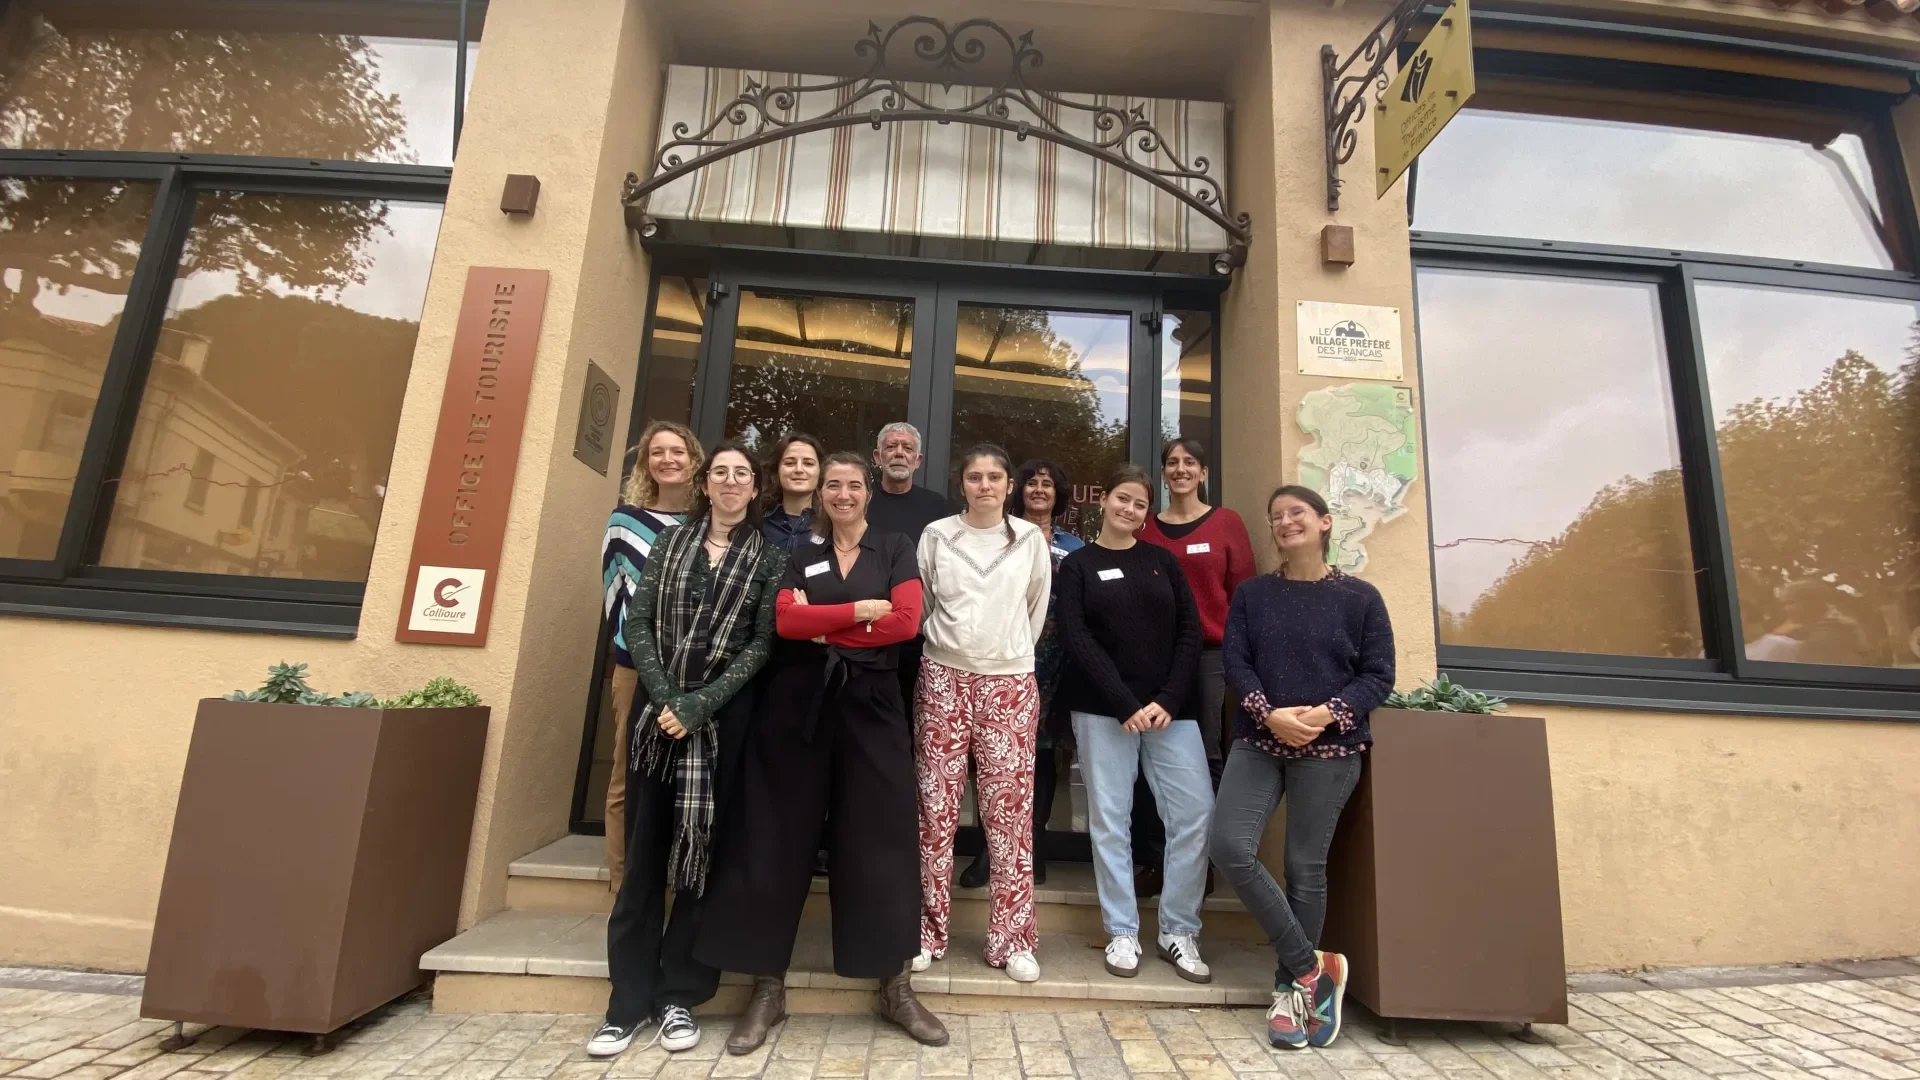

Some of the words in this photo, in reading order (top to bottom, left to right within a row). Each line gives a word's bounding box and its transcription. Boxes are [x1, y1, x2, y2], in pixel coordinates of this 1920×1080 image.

[1401, 101, 1426, 134] Offices
[1402, 103, 1437, 145] Tourisme
[1410, 116, 1437, 151] France
[474, 283, 516, 404] TOURISME
[1309, 335, 1348, 347] VILLAGE
[1350, 338, 1391, 350] PRÉFÉRÉ
[1318, 327, 1330, 336] LE
[1317, 345, 1336, 354] DES
[1337, 347, 1383, 358] FRANÇAIS
[465, 413, 492, 444] DE
[447, 453, 485, 546] OFFICE
[422, 607, 467, 619] Collioure
